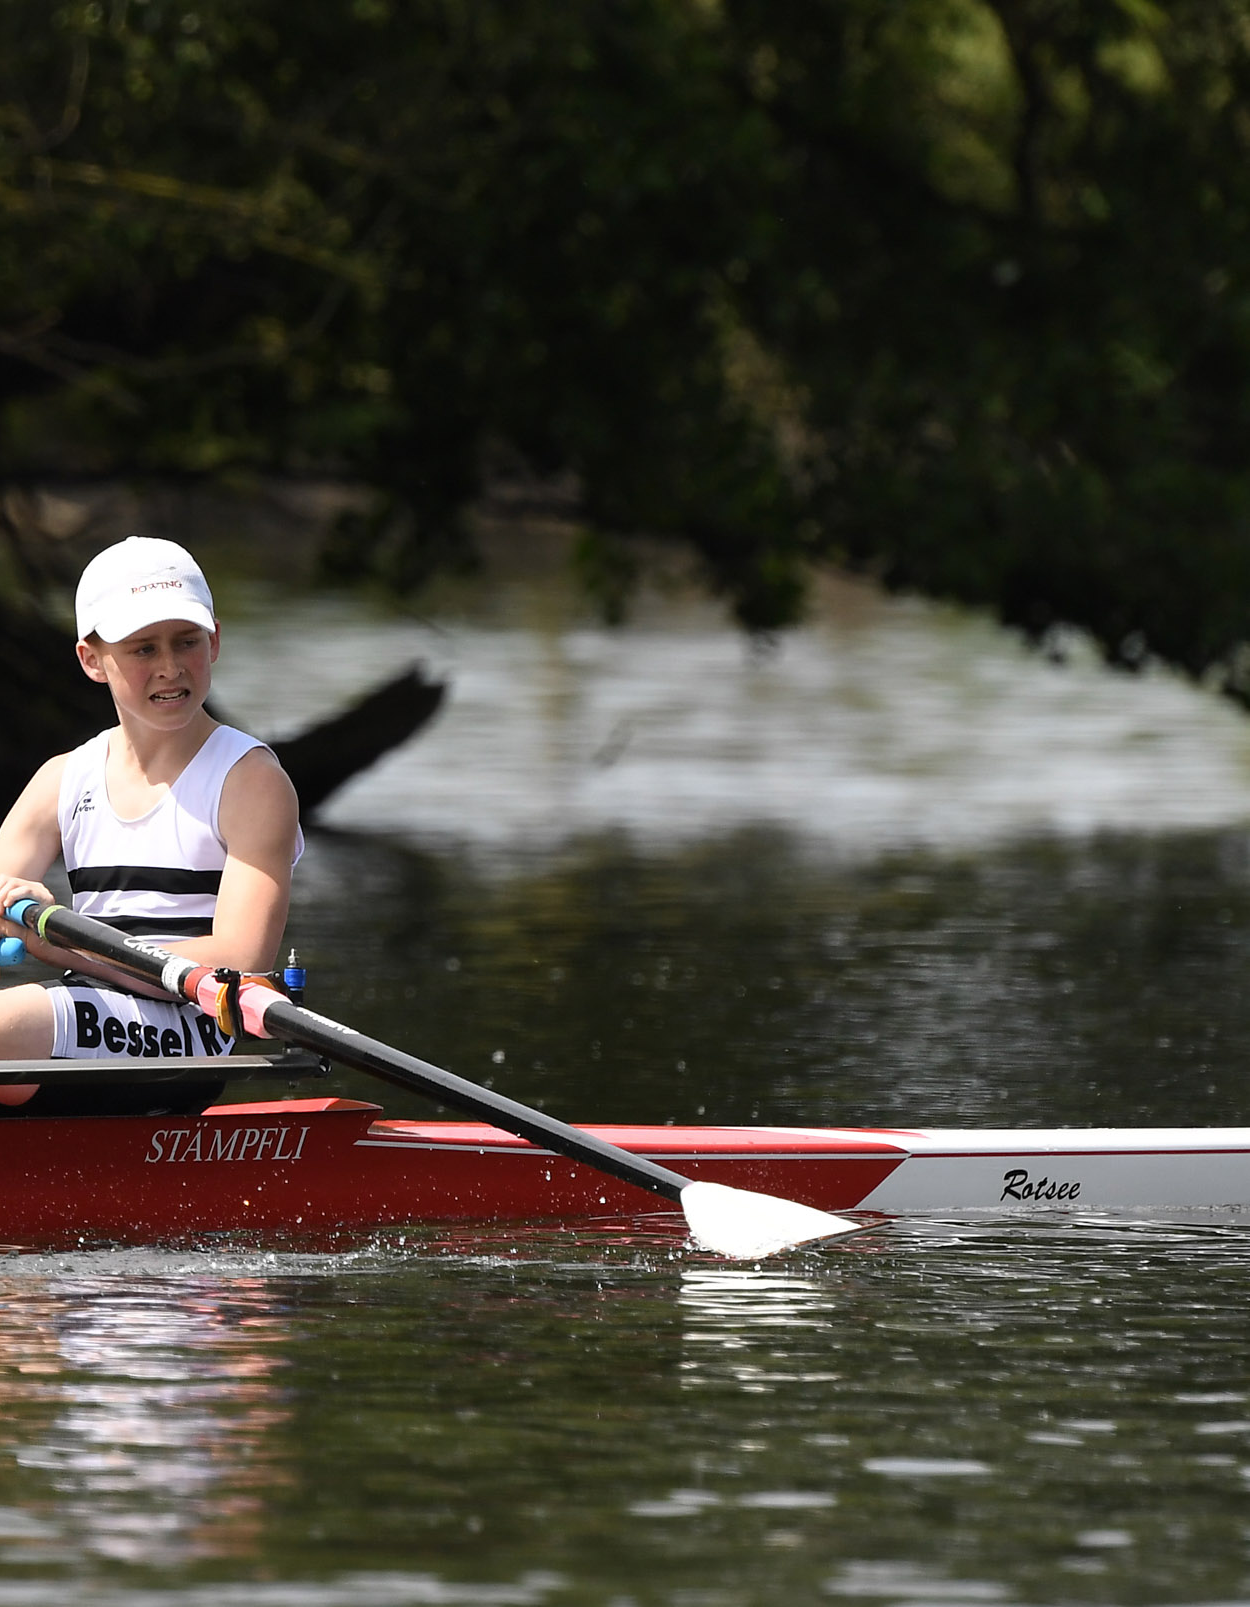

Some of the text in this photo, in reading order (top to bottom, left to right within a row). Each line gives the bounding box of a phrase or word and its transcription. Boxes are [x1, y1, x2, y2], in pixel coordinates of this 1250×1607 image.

[131, 580, 183, 595] ROWING
[74, 1001, 234, 1058] Bessel R
[145, 1122, 311, 1163] STÄMPFLI
[999, 1168, 1082, 1202] Rotsee
